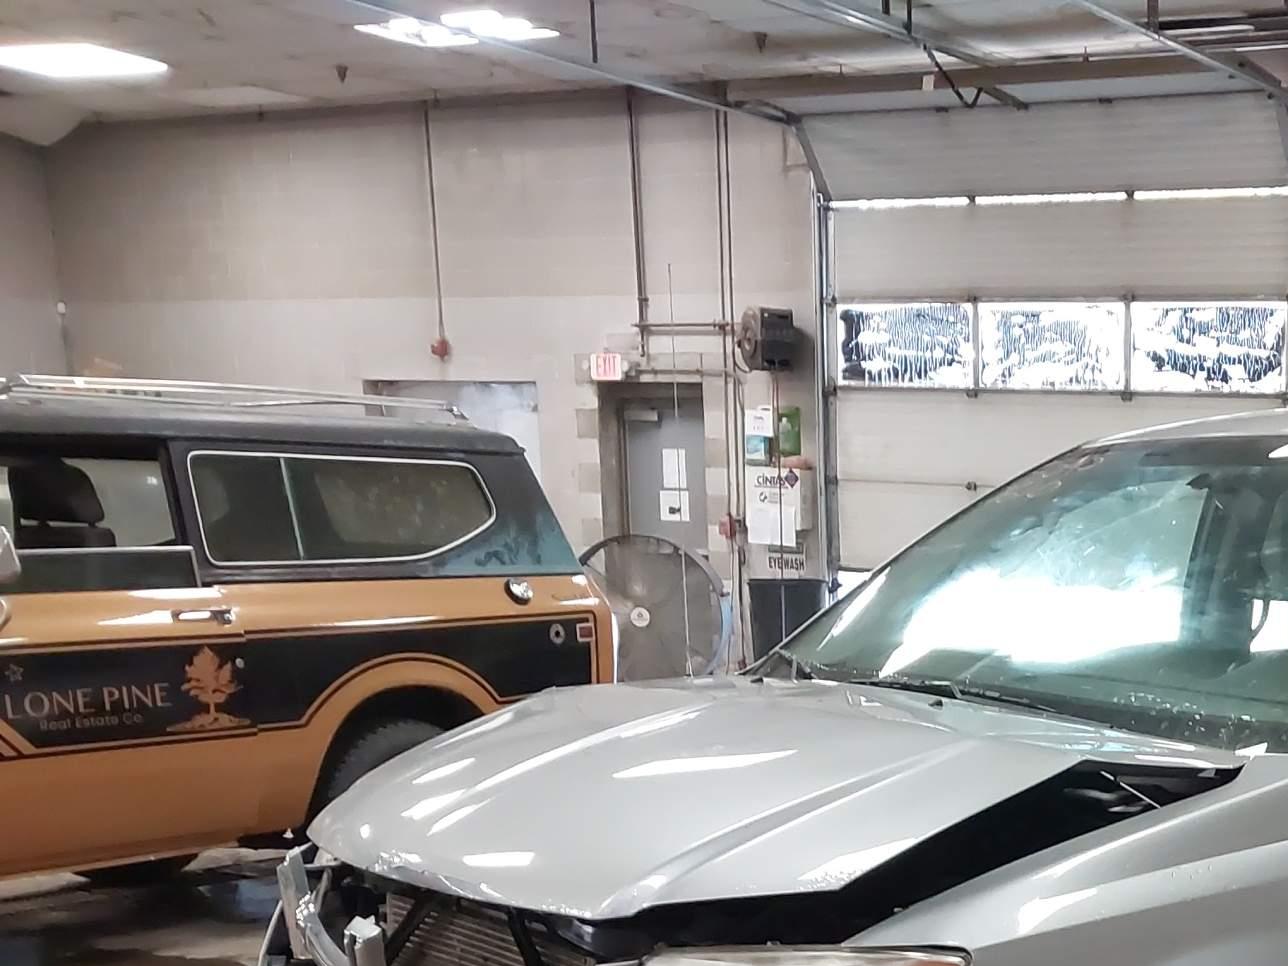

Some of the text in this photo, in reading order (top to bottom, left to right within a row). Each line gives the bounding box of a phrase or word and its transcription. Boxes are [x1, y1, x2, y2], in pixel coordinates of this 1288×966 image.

[596, 354, 617, 378] EXIT
[768, 556, 805, 571] EYE WASH
[4, 682, 173, 720] LONE PINE
[39, 716, 72, 731] Real
[75, 715, 120, 729] Estate
